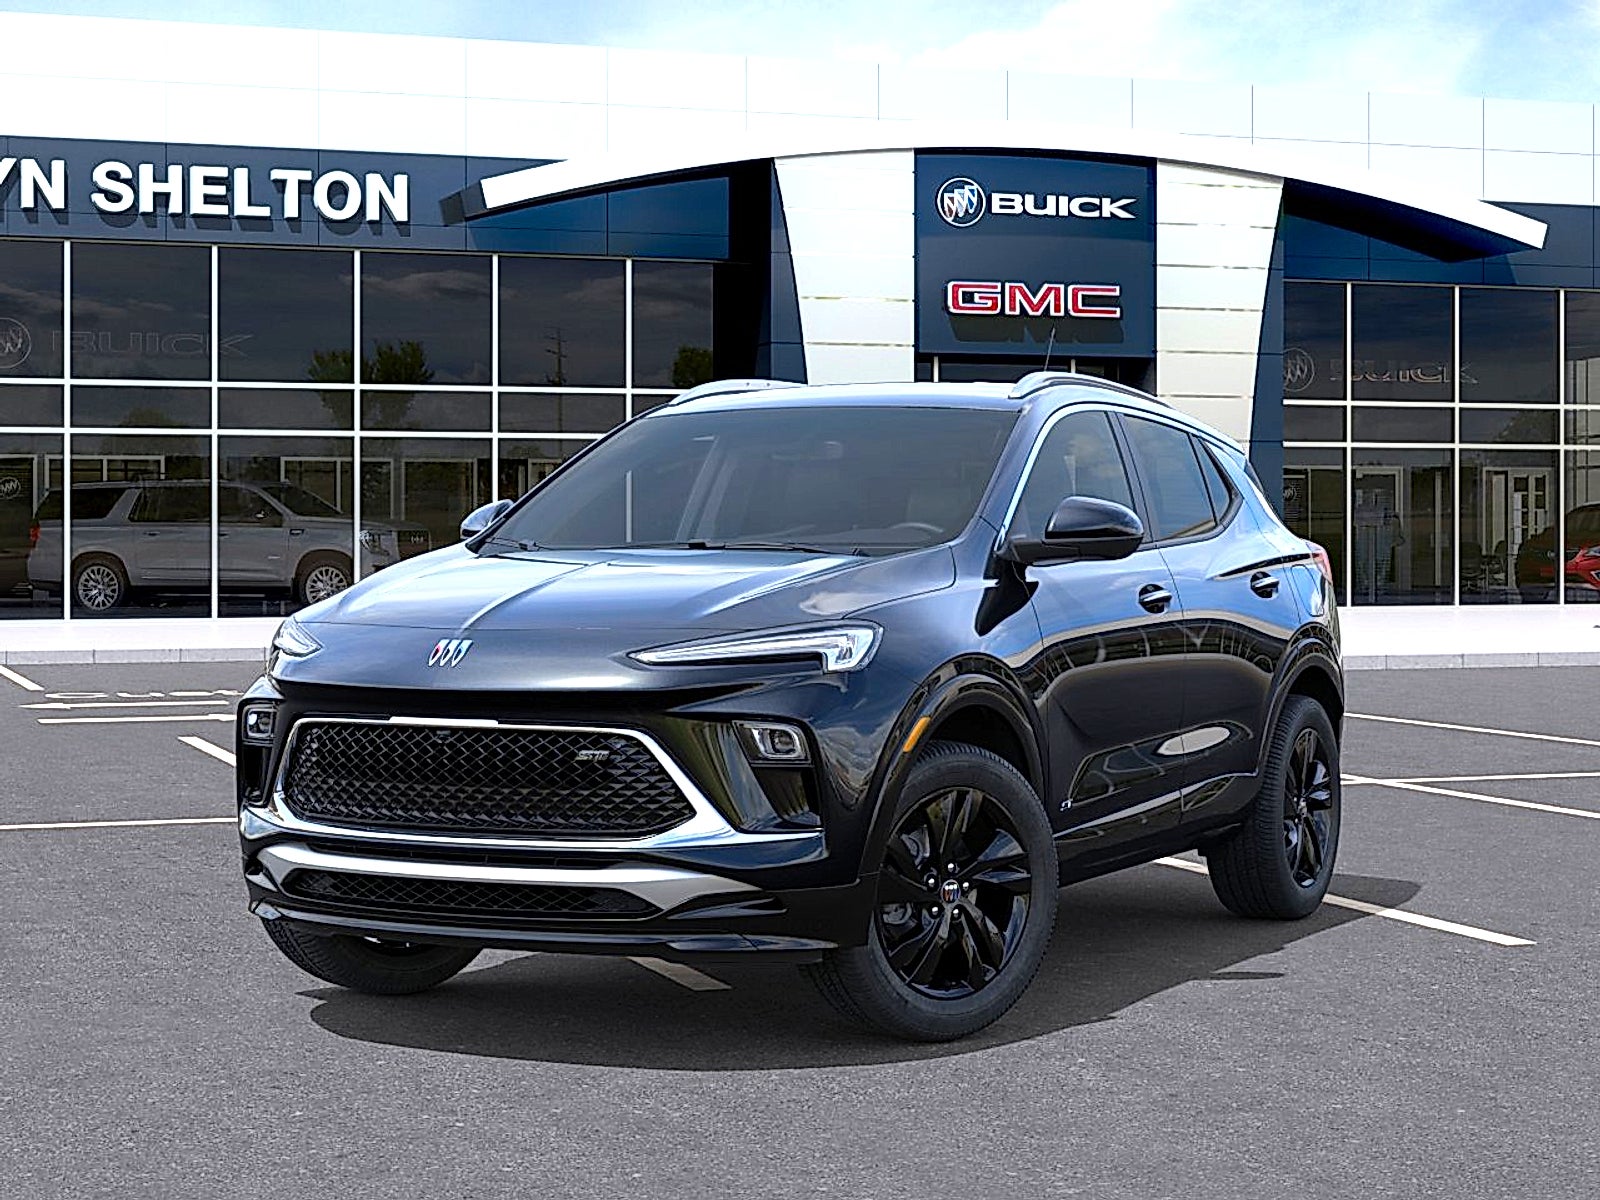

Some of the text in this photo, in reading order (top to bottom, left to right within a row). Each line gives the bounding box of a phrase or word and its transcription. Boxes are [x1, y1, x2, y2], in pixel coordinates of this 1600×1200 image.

[91, 160, 409, 223] SHELTON
[991, 192, 1137, 219] BUICK
[947, 281, 1121, 318] GMC
